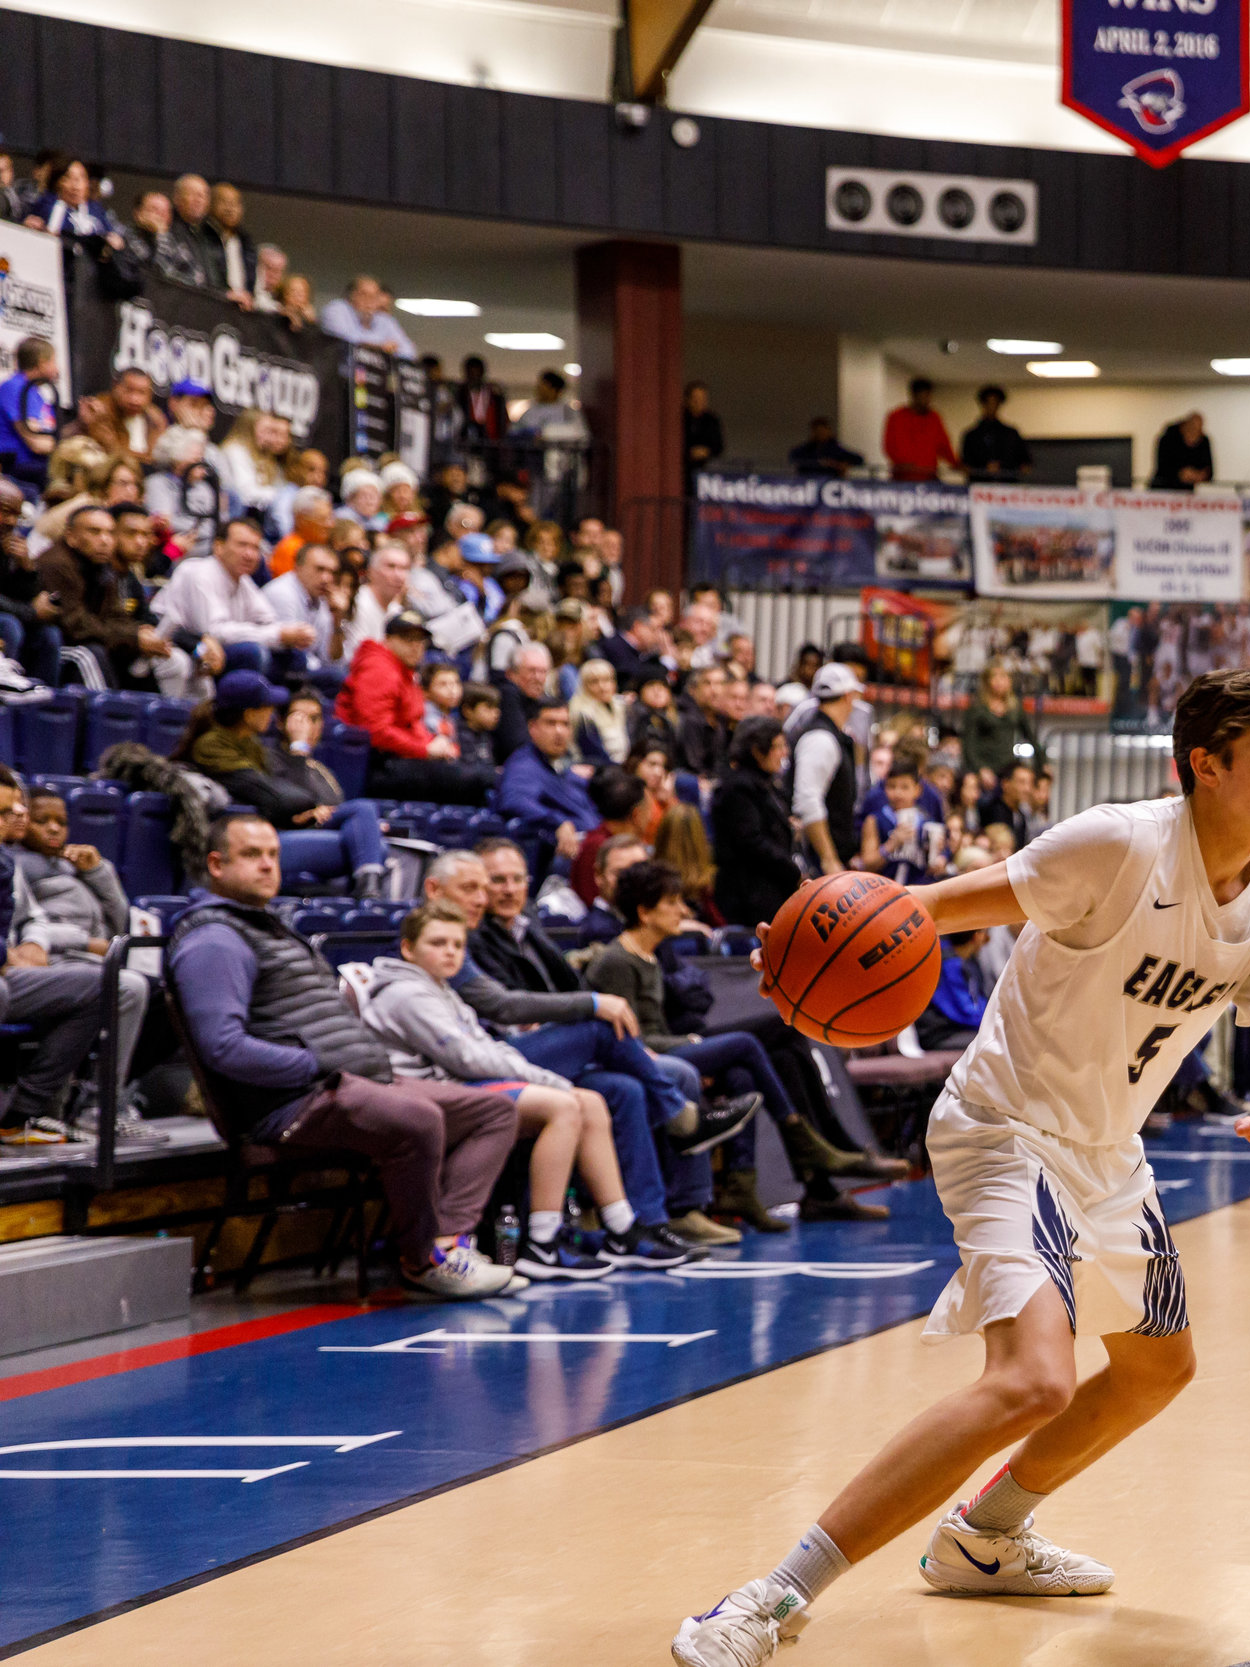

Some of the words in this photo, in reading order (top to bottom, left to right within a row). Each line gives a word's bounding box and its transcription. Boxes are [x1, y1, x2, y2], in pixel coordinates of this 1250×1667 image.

[1094, 26, 1150, 54] APRIL
[1153, 30, 1173, 58] 2,
[1174, 31, 1220, 60] 2016
[697, 473, 818, 507] National
[973, 488, 1086, 509] National
[811, 877, 893, 943] Baden
[858, 908, 925, 971] ELITE
[1122, 952, 1238, 1014] EAGLE
[1127, 1022, 1183, 1086] 5
